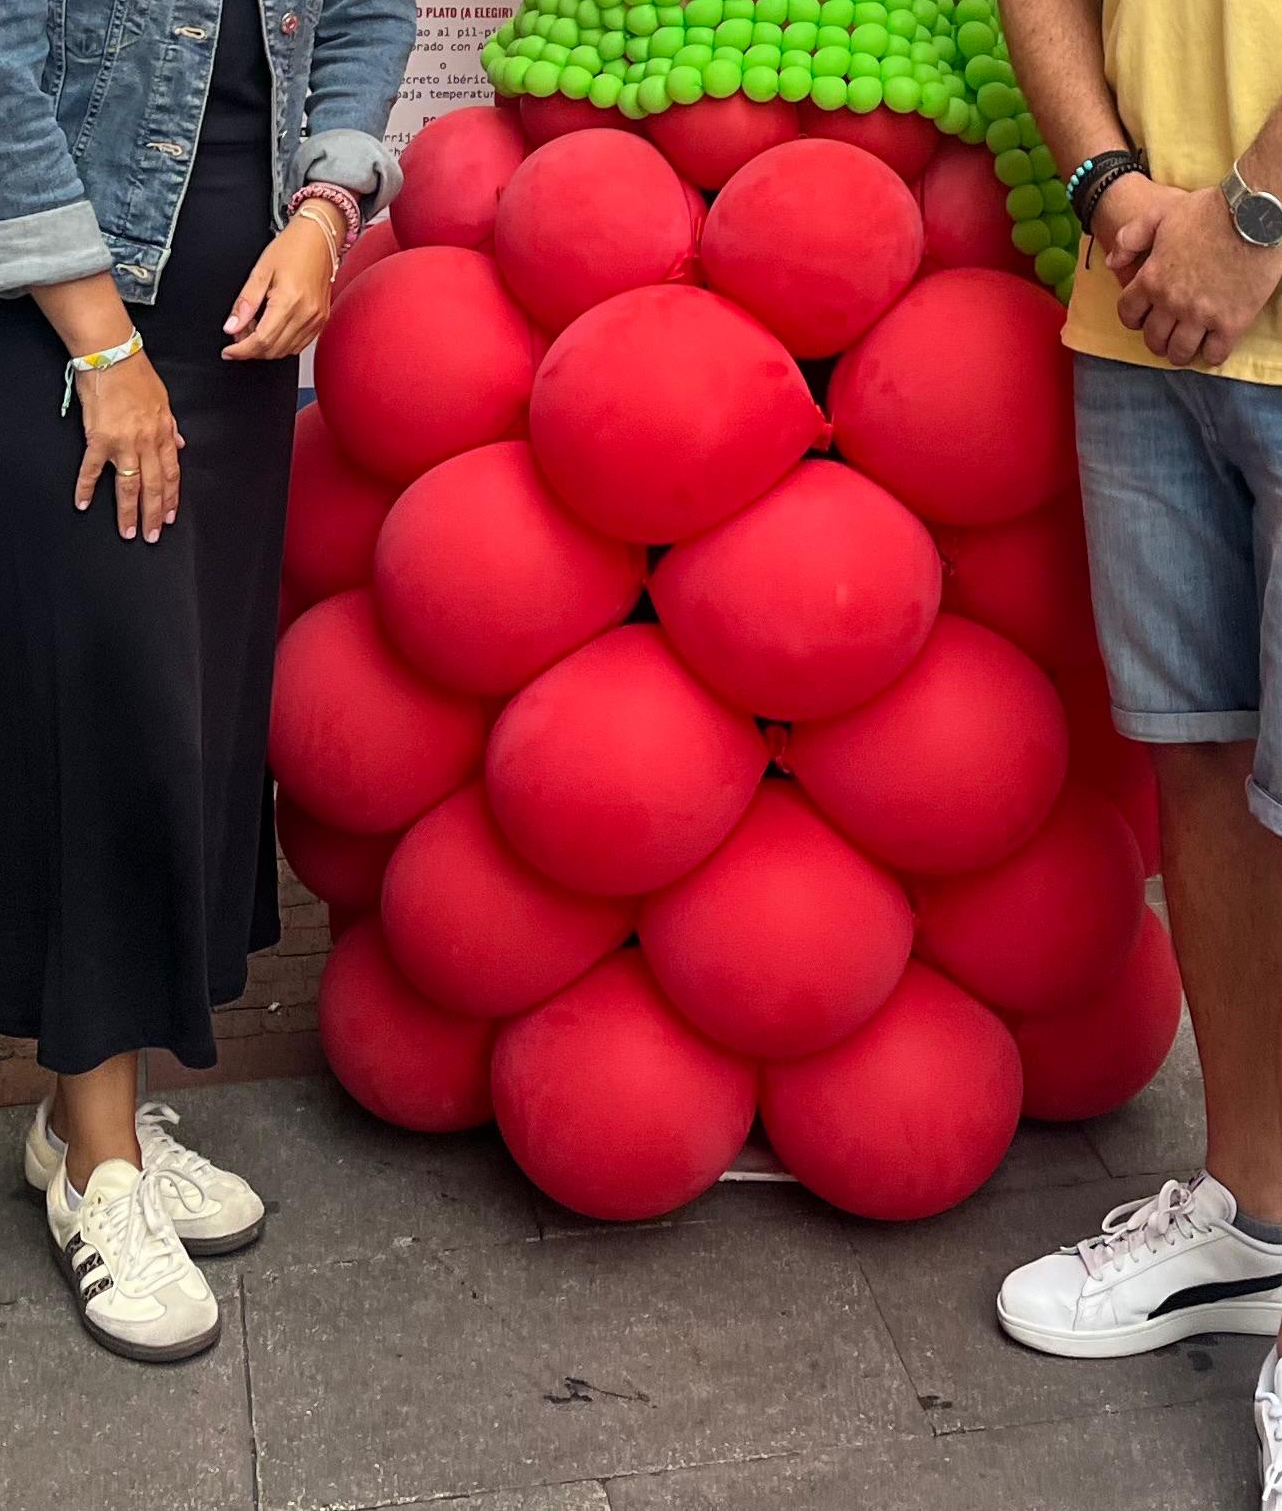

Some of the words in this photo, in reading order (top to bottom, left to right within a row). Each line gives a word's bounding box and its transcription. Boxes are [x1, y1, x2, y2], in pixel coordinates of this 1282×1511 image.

[426, 7, 457, 19] PLATO
[460, 7, 471, 21] (A
[474, 7, 513, 20] ELEGIR)
[437, 26, 450, 37] al
[457, 26, 496, 39] pil-p
[451, 43, 471, 51] con
[439, 62, 447, 70] o
[402, 74, 440, 85] creto
[430, 90, 495, 101] temperatur
